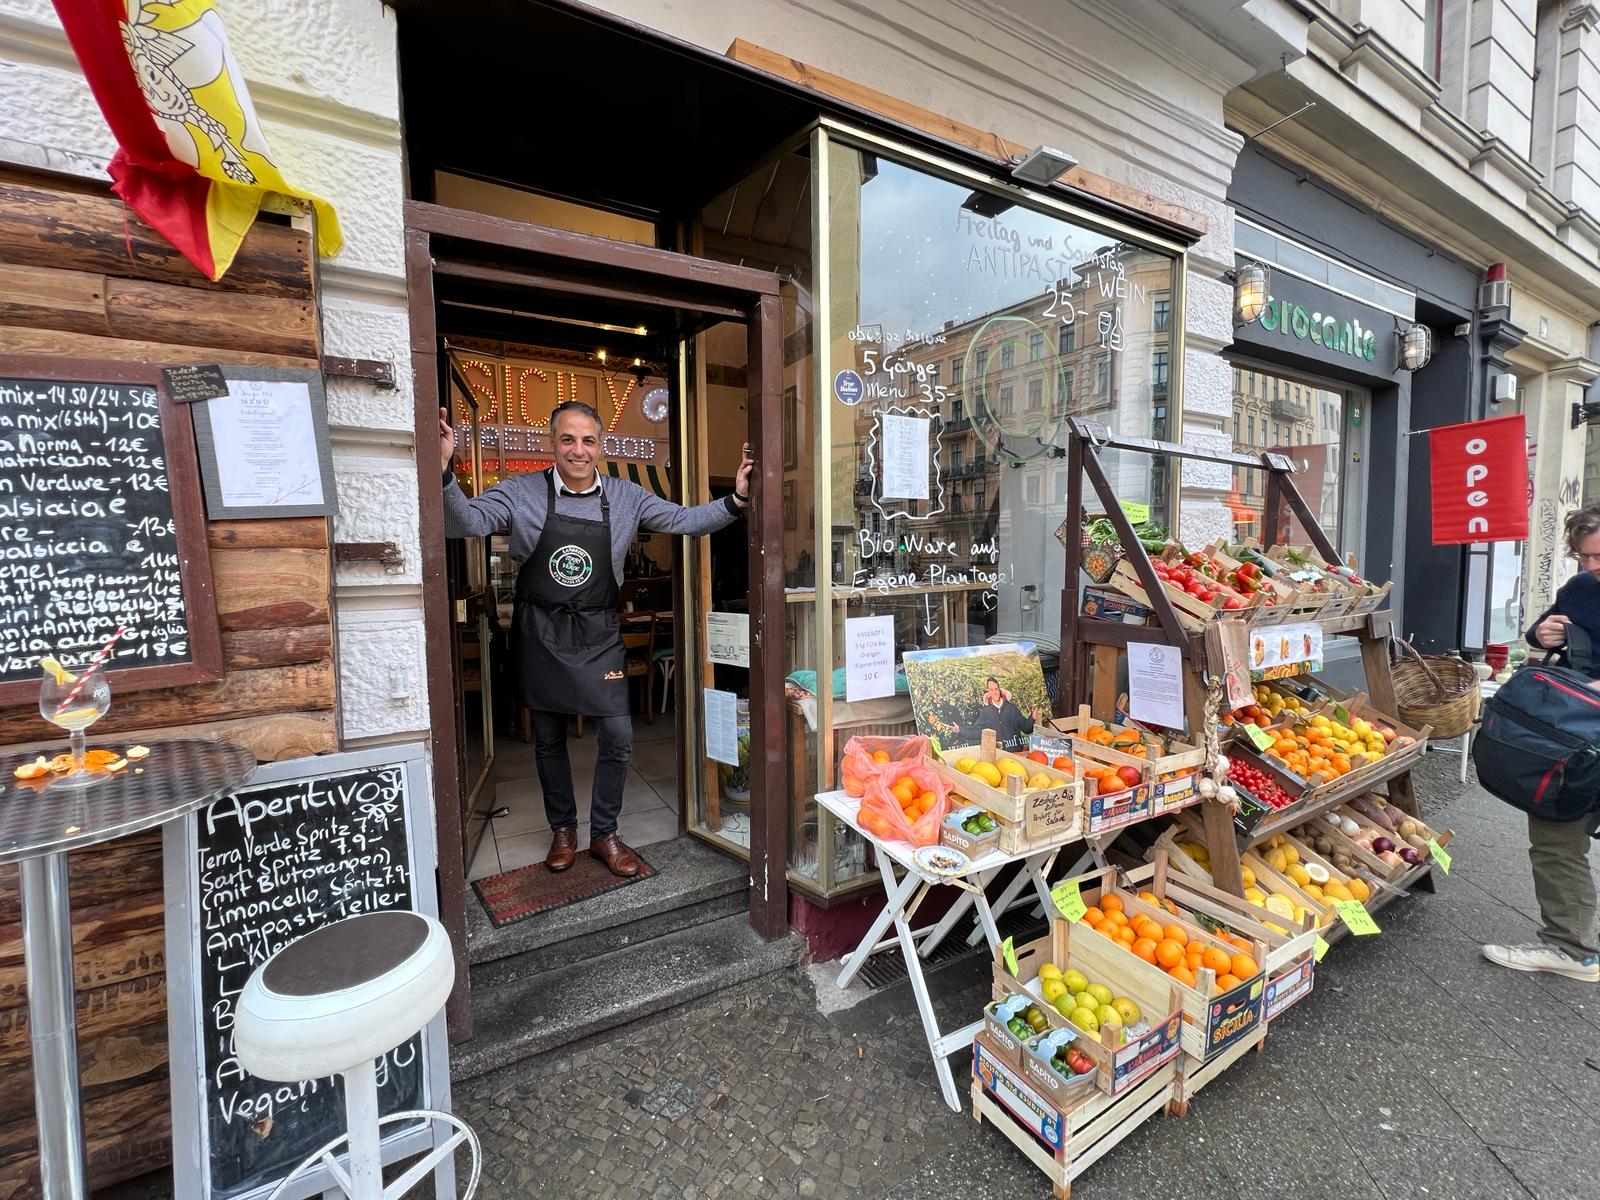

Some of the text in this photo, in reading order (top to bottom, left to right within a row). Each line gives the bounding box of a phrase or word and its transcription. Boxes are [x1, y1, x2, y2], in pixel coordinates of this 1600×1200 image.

[956, 206, 1021, 251] Freitag
[1027, 235, 1053, 251] und
[966, 243, 1075, 289] ANTIPASTI
[1098, 271, 1146, 305] WEIN
[863, 350, 937, 381] 5 Gänge
[457, 360, 636, 432] SICILY
[603, 435, 655, 460] OOD
[1465, 438, 1489, 533] open
[859, 529, 894, 559] Bio
[904, 534, 958, 556] Ware
[850, 568, 921, 596] Eigene
[0, 651, 110, 674] verure
[1004, 734, 1018, 748] auf
[207, 781, 380, 837] Aperitivo
[198, 847, 242, 873] Terra
[244, 831, 292, 864] Verde
[295, 815, 351, 847] Spritz
[259, 844, 322, 877] Spritz
[206, 888, 320, 930] Limoncello
[329, 871, 385, 899] Spritz
[335, 890, 407, 918] Teller
[219, 1072, 319, 1125] Vegan
